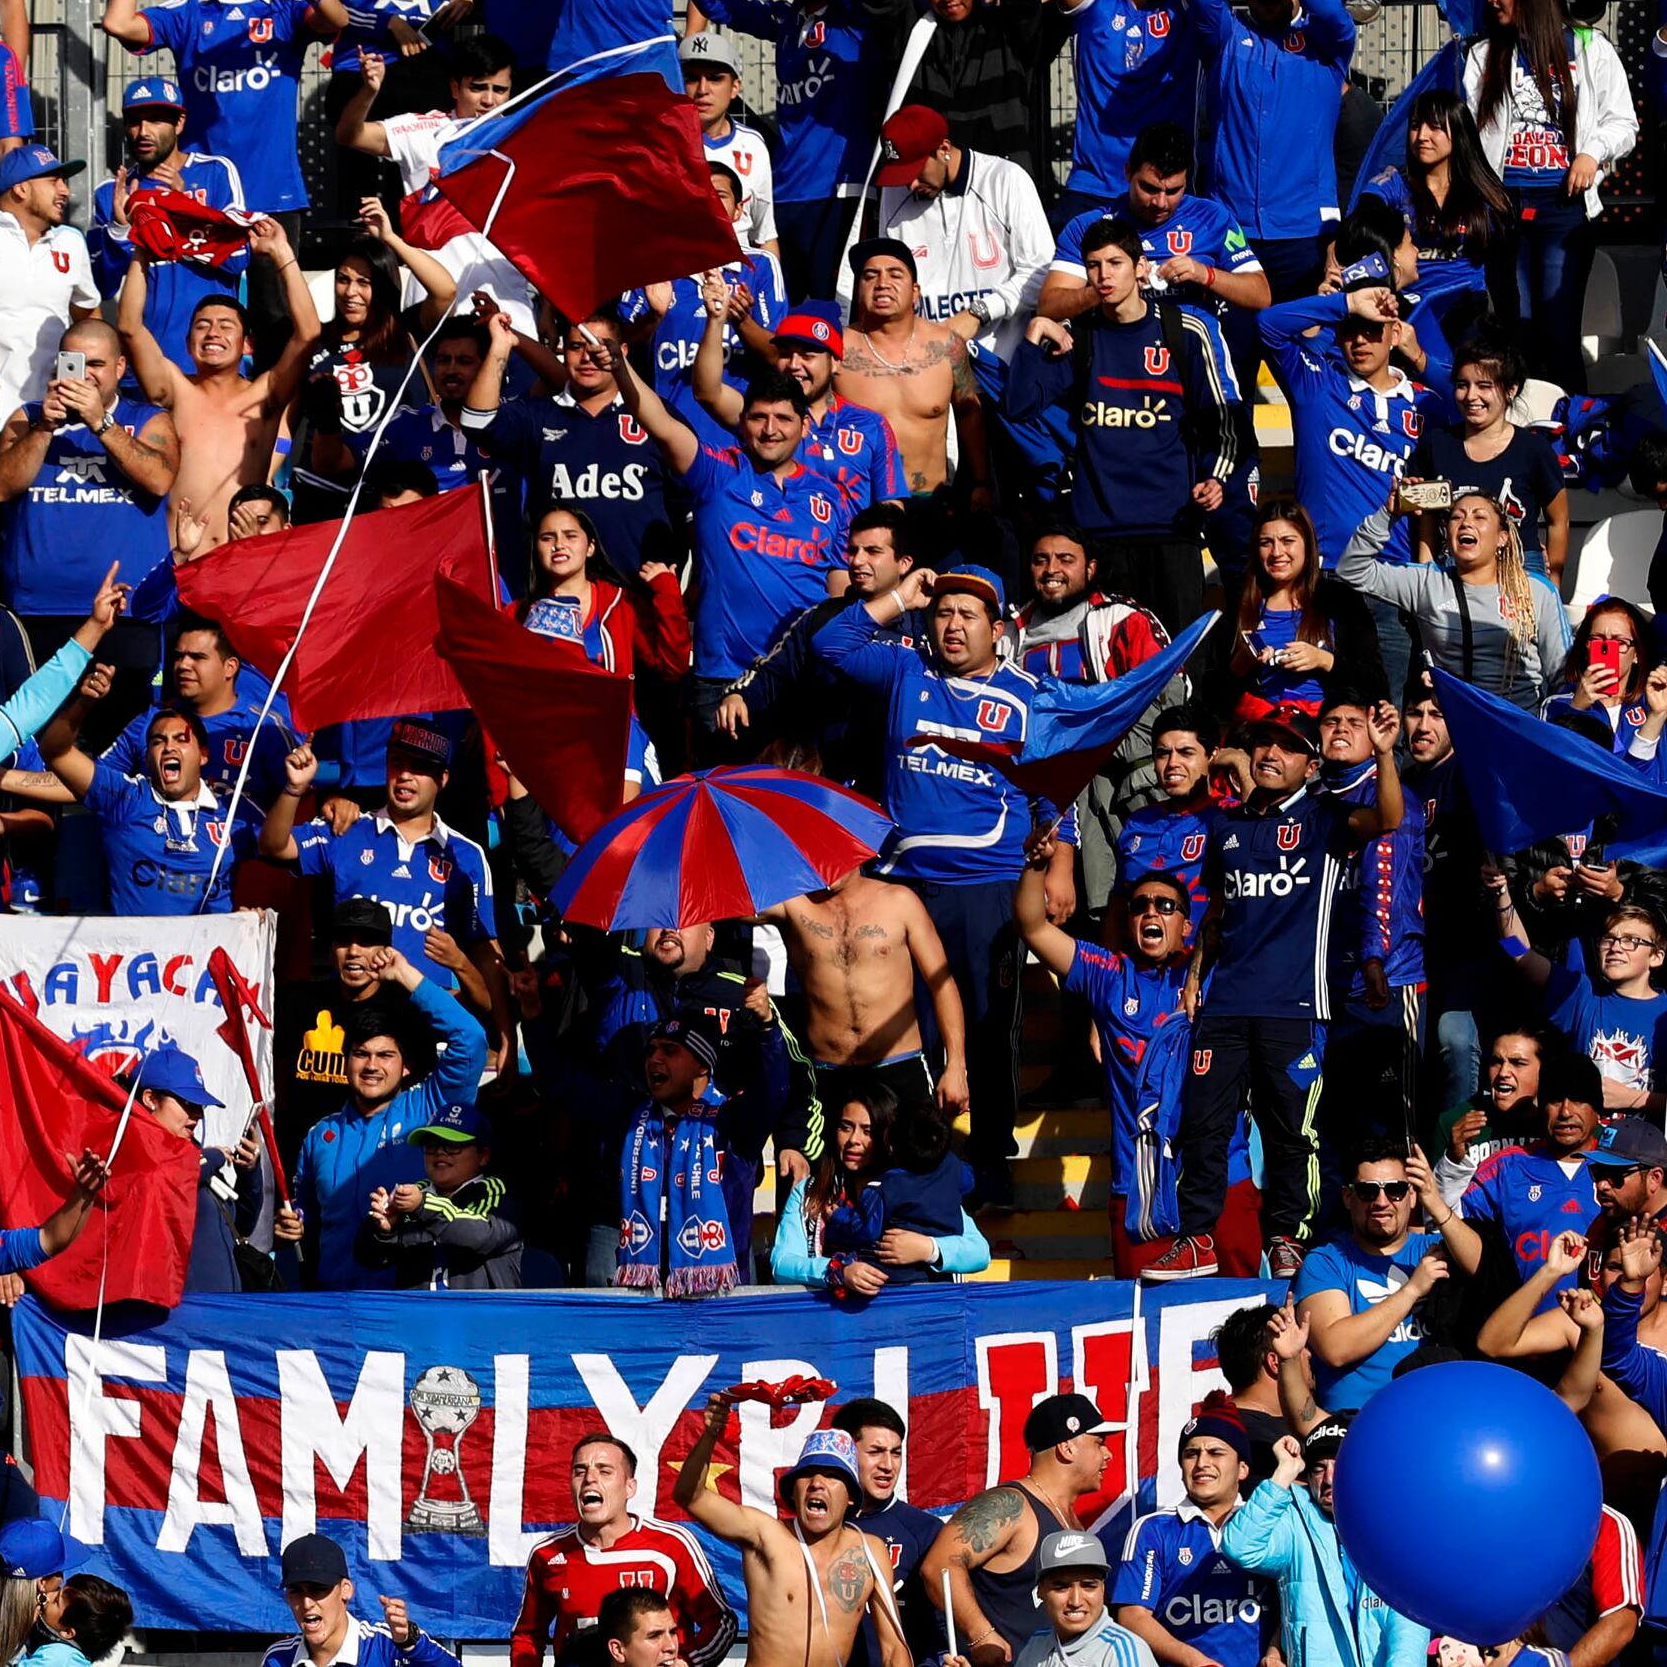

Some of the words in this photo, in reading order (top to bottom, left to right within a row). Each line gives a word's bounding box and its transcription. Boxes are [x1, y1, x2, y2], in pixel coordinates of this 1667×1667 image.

[248, 18, 273, 43] U
[1147, 10, 1171, 37] U
[691, 37, 709, 54] NY
[194, 64, 272, 93] Claro
[1512, 132, 1554, 146] DALE
[731, 150, 753, 176] U
[967, 230, 1001, 270] U
[1166, 230, 1193, 256] U
[50, 250, 71, 274] U
[1143, 347, 1171, 376] U
[1082, 400, 1156, 429] Claro
[618, 414, 649, 446] U
[838, 429, 864, 455] U
[28, 486, 134, 506] TELMEX
[552, 462, 644, 501] AdeS
[809, 495, 832, 524] U
[729, 522, 821, 566] Claro
[976, 699, 1013, 731] U
[897, 753, 994, 789] TELMEX
[1180, 833, 1206, 861] U
[1276, 822, 1302, 851] U
[427, 856, 452, 884] U
[1224, 866, 1292, 899] Claro
[629, 1109, 650, 1195] UNIVERSIDAD
[66, 1332, 719, 1567] FAMLY
[1305, 1424, 1348, 1446] adida
[1141, 1549, 1157, 1602] TRAMONTINA
[1166, 1595, 1261, 1626] Claro
